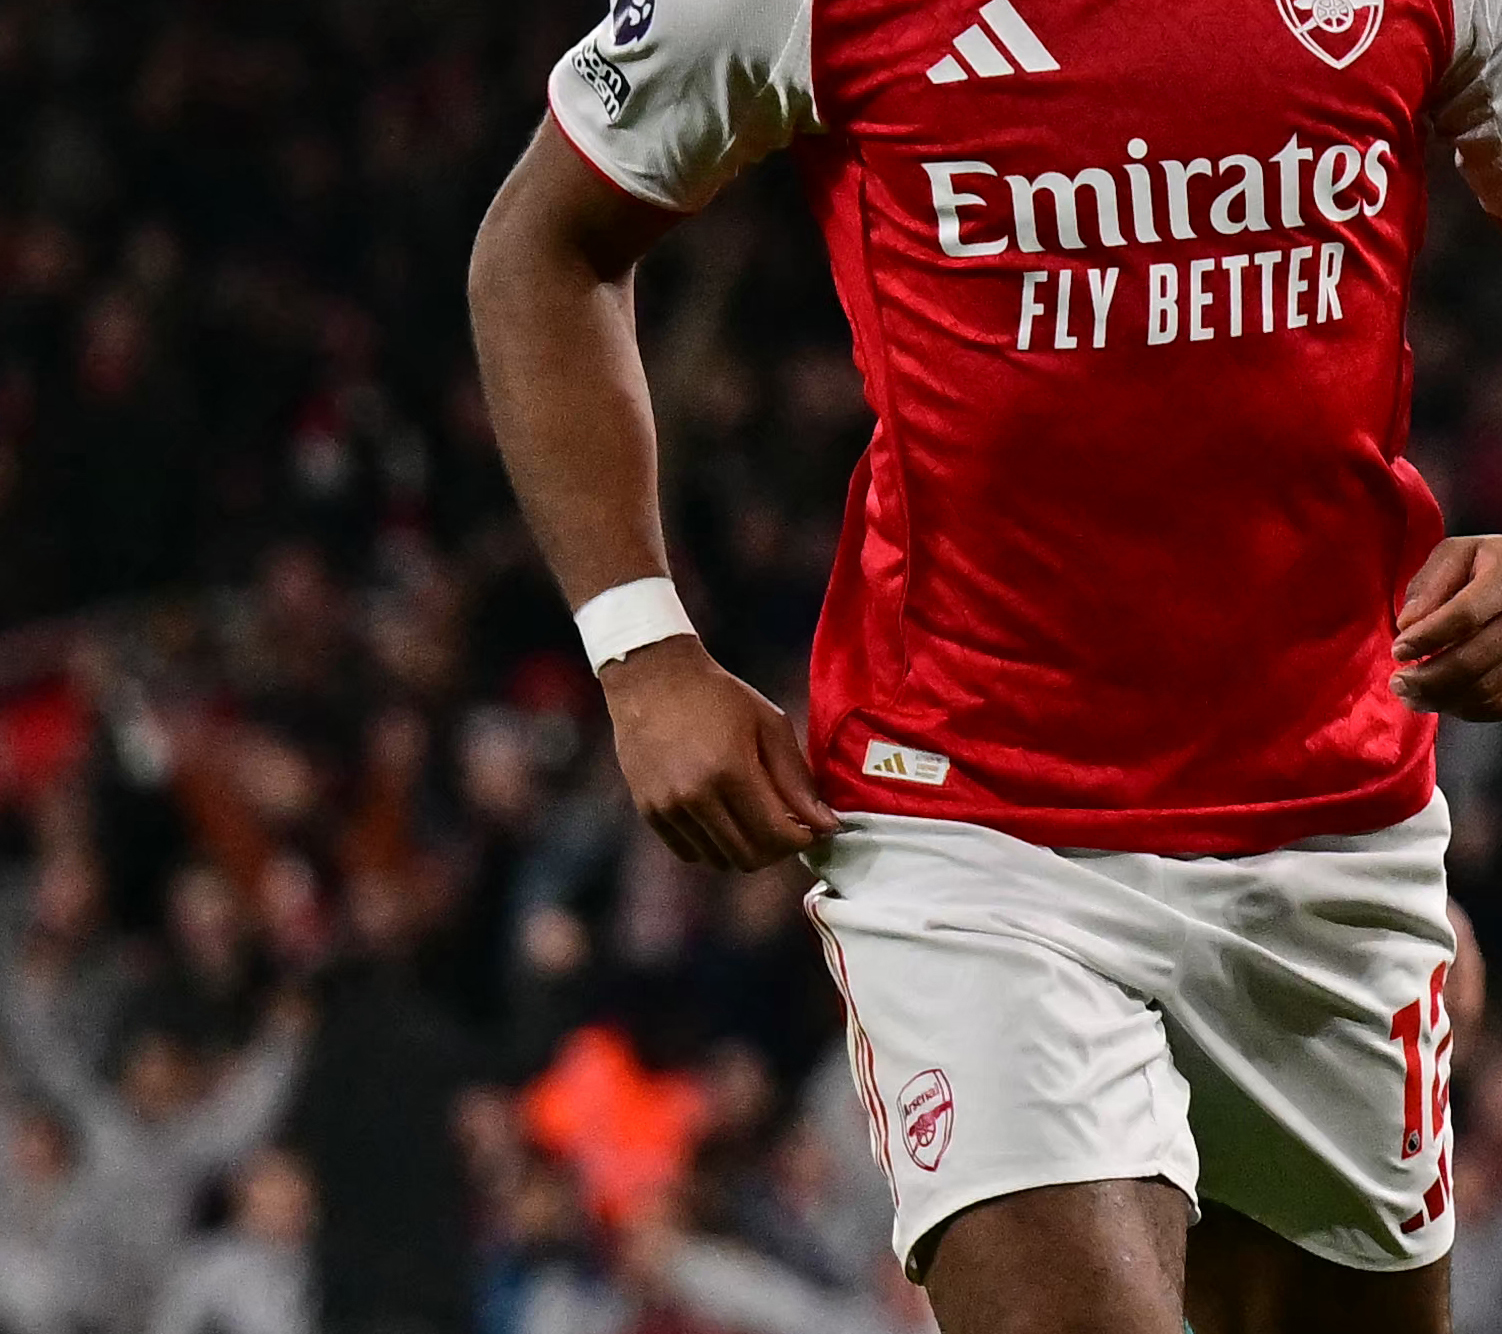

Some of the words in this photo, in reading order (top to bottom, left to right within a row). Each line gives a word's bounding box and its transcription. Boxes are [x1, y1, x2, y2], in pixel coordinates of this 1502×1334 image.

[921, 133, 1391, 258] Emirates
[1017, 267, 1120, 350] FLY
[1147, 242, 1345, 346] BETTER
